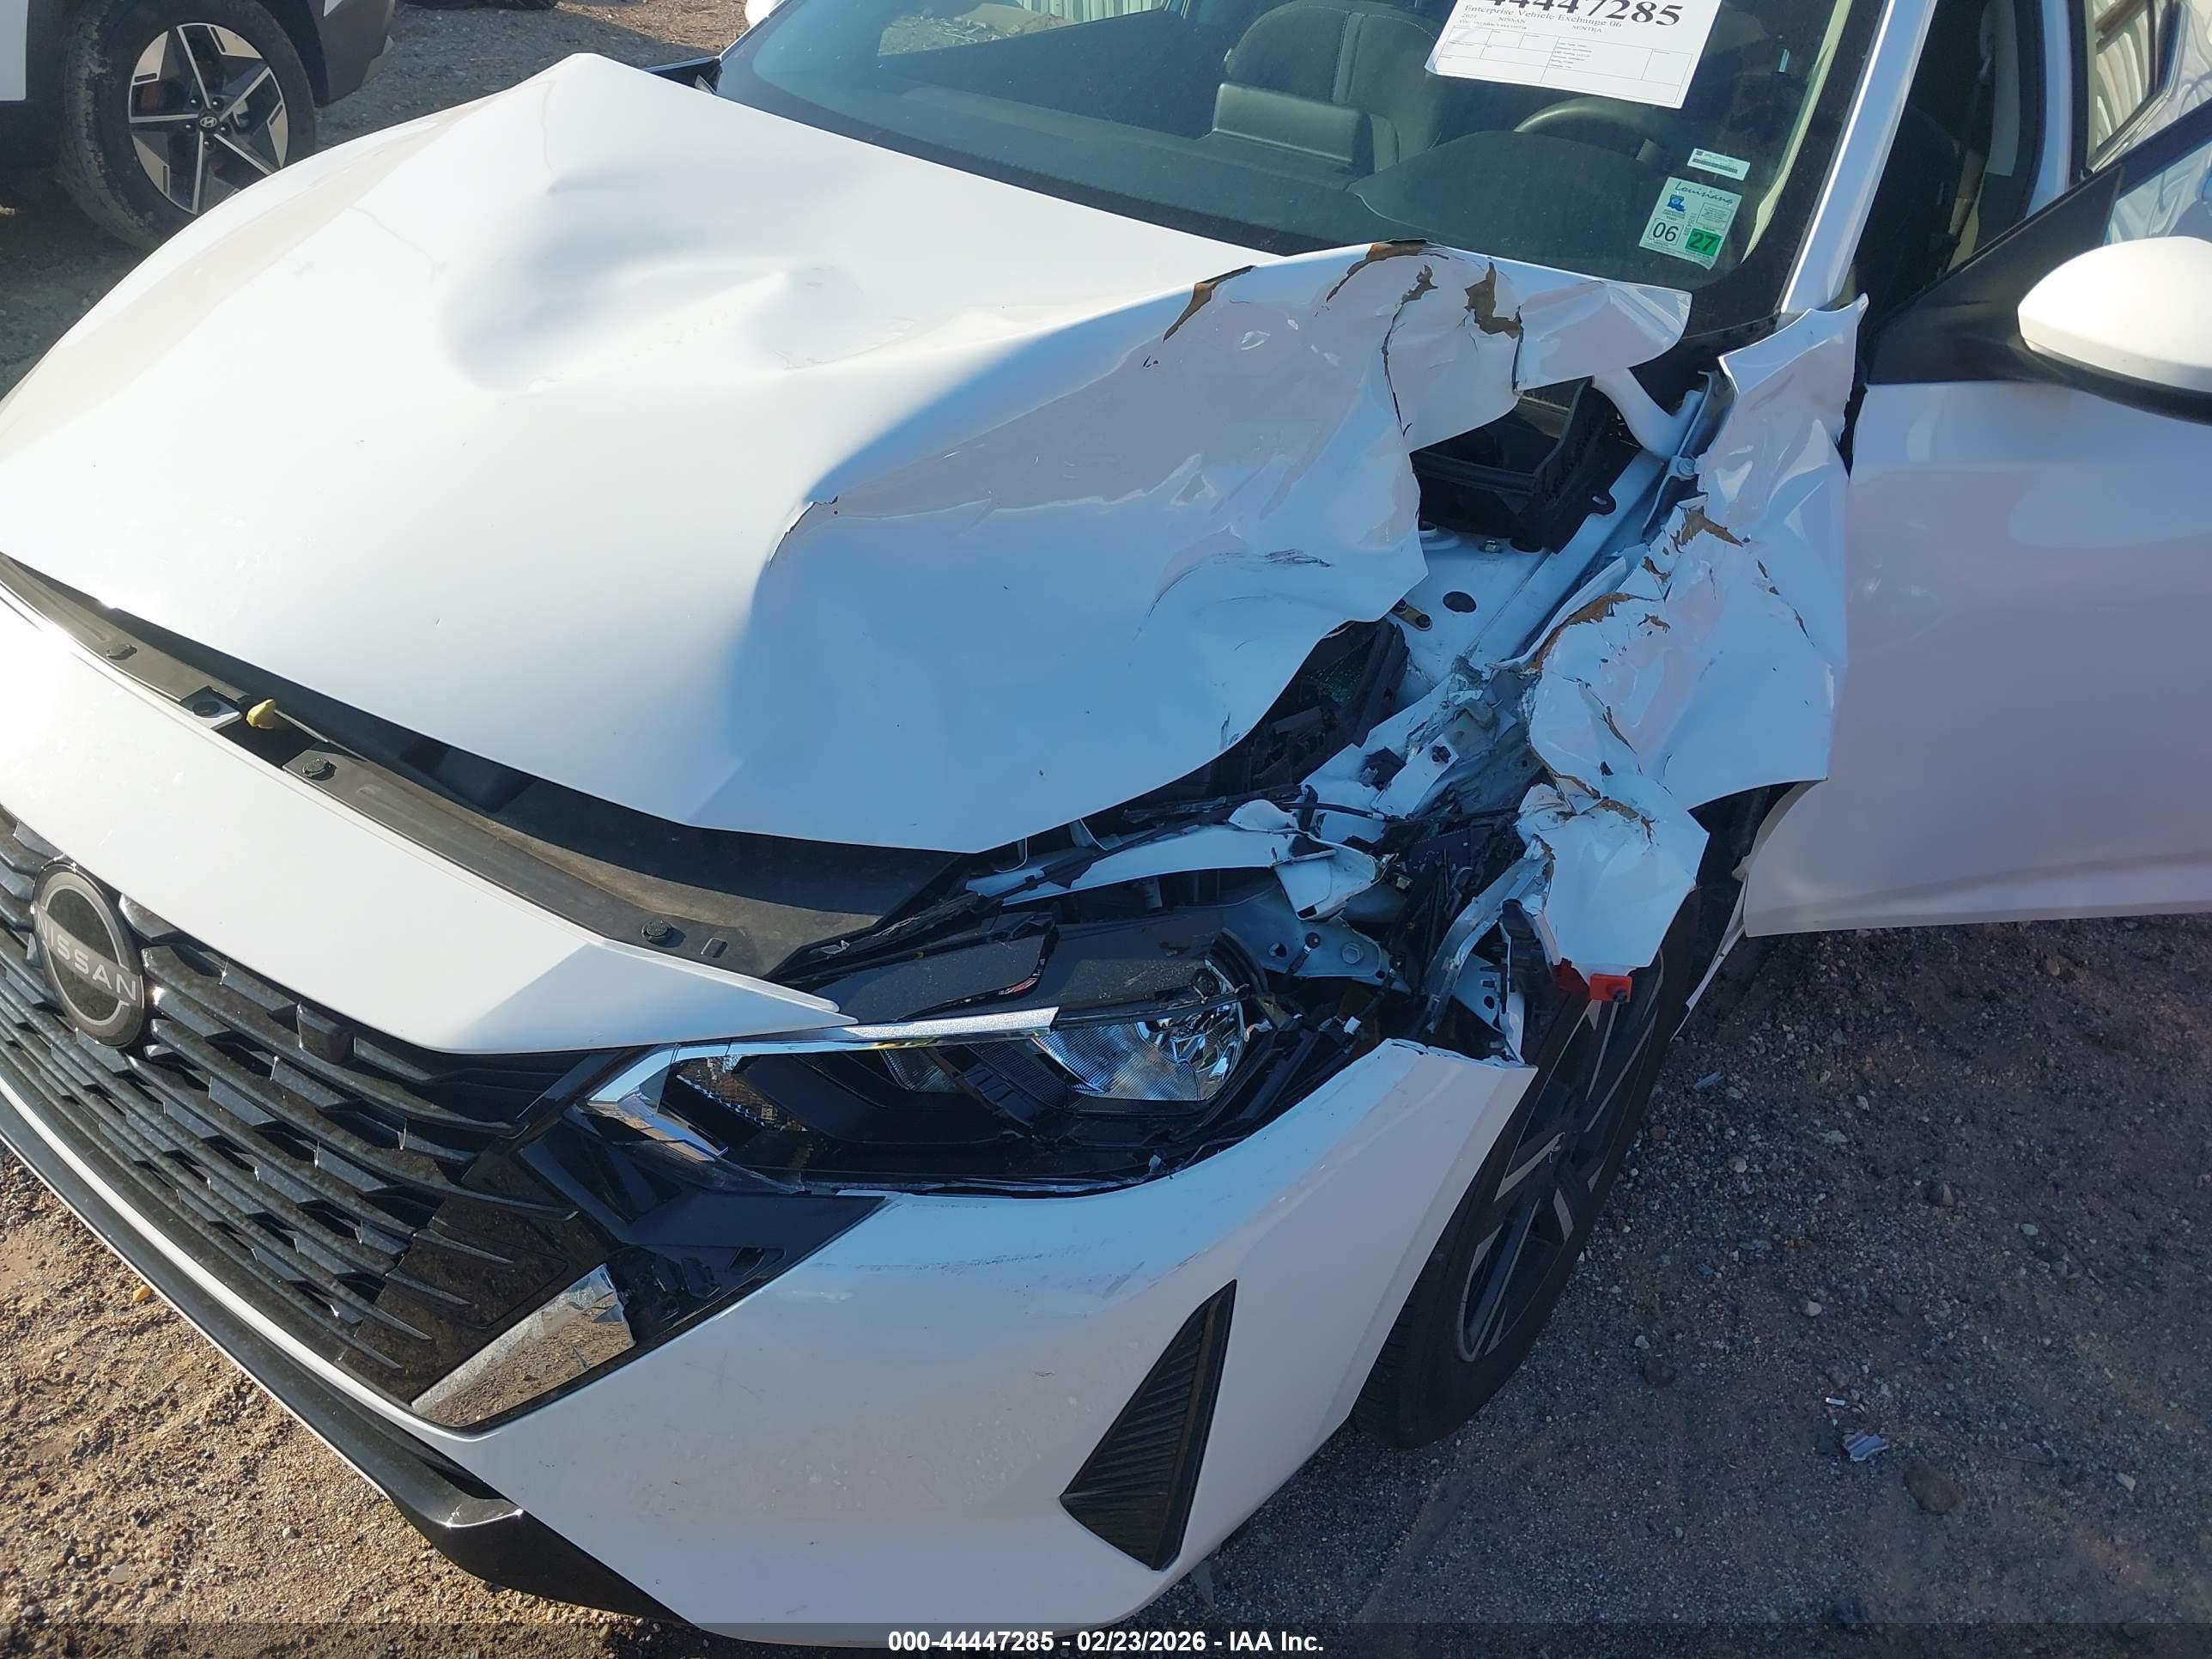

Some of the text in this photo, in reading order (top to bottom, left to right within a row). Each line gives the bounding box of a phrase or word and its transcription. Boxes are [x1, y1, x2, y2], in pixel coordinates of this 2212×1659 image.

[1464, 4, 1623, 28] Enterprise Vehicle Exchange 06
[1485, 0, 1683, 26] 447285
[1572, 25, 1602, 33] SENTRA
[1675, 181, 1733, 205] Louisiana
[1652, 222, 1679, 242] 06
[1688, 232, 1717, 252] 27
[37, 910, 137, 1000] NISSAN
